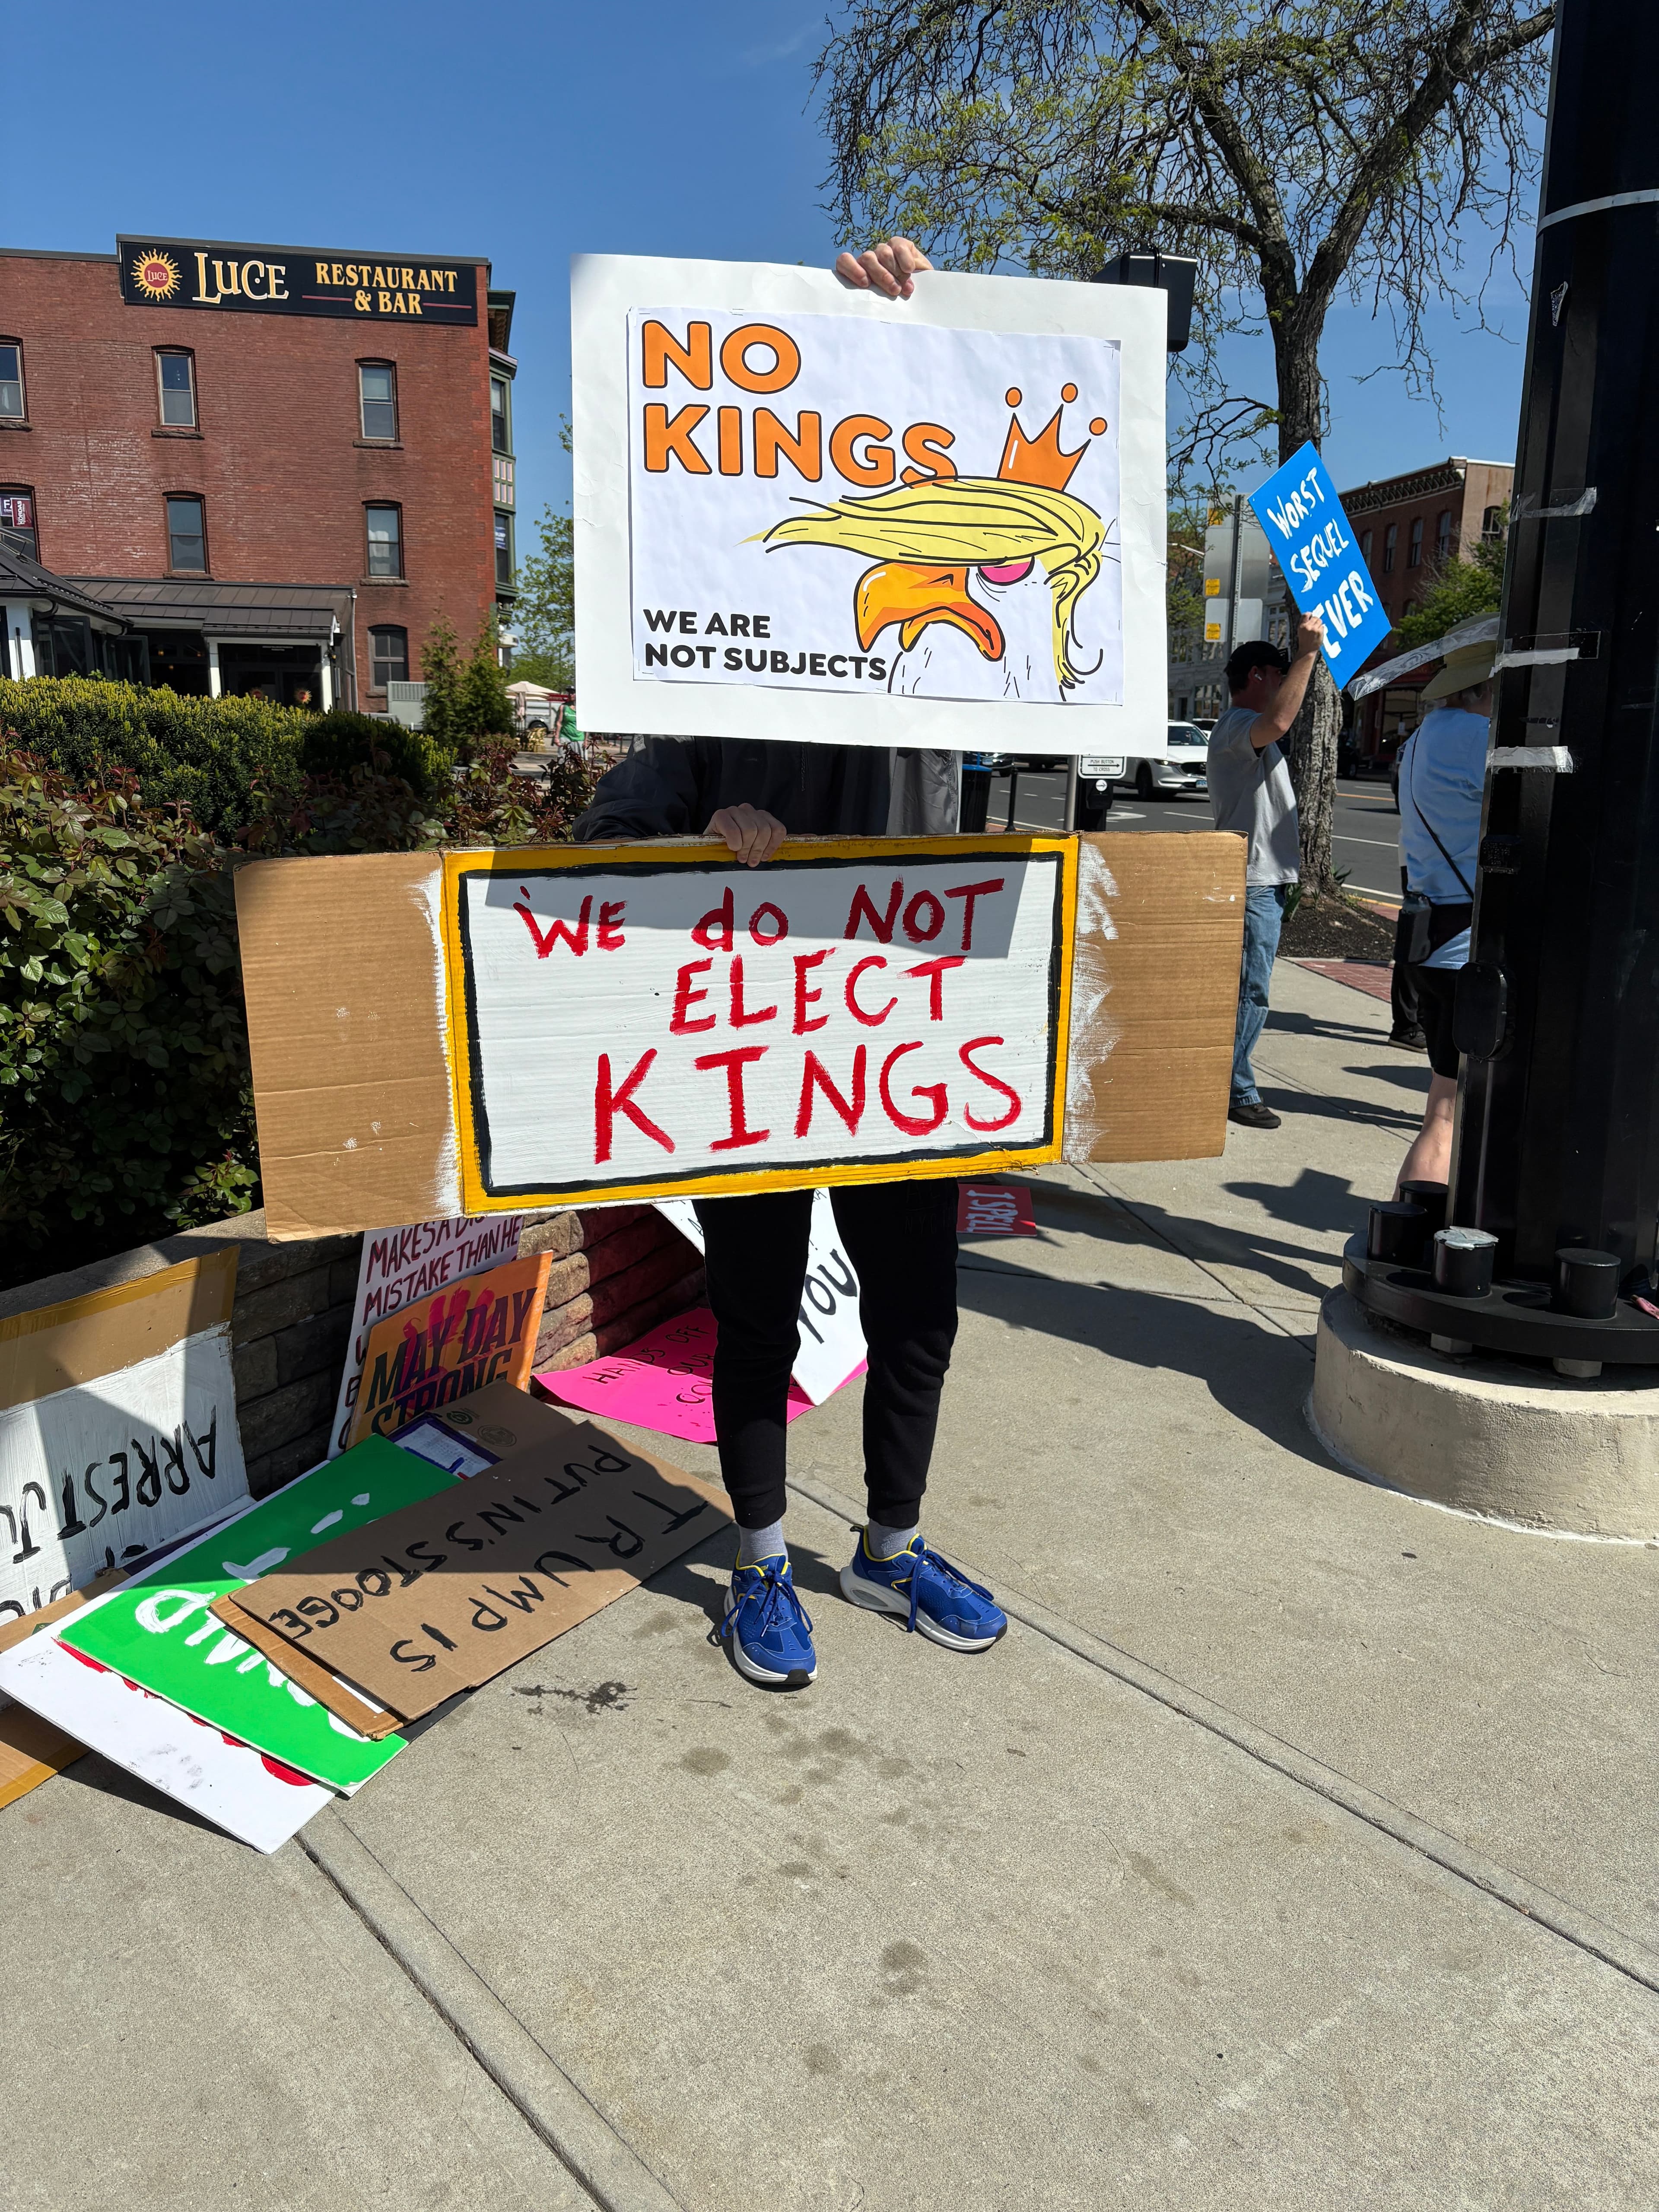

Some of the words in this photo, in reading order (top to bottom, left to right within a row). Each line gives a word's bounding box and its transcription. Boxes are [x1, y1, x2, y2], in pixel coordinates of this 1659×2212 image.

[192, 252, 289, 303] LUCE
[315, 262, 458, 292] RESTAURANT
[354, 290, 372, 312] &
[378, 291, 423, 315] BAR
[642, 320, 801, 394] NO
[643, 403, 957, 487] KINGS
[1267, 467, 1325, 540] WORST
[1290, 518, 1349, 592] SEQUEL
[643, 609, 697, 635] WE
[705, 612, 770, 639] ARE
[1312, 570, 1374, 658] EVER
[645, 642, 716, 669] NOT
[724, 648, 887, 681] SUBJECTS
[513, 895, 628, 959] WE
[691, 887, 789, 952] do
[844, 878, 1005, 951] NOT
[670, 947, 967, 1036] ELECT
[594, 1036, 1021, 1165] KINGS
[363, 1250, 454, 1326] MISTAKE
[457, 1224, 500, 1272] THAN
[501, 1216, 522, 1252] HE
[366, 1221, 435, 1284] MAKES
[436, 1219, 450, 1246] A
[364, 1316, 455, 1414] MAY
[457, 1287, 537, 1364] DAY
[582, 1348, 666, 1384] HANDS
[665, 1325, 710, 1344] OFF
[667, 1353, 714, 1376] OUR
[372, 1348, 512, 1437] STRONG
[57, 1405, 217, 1541] ARREST
[269, 1540, 448, 1640] STOOGE
[471, 1491, 710, 1632] TRUMP
[390, 1623, 458, 1672] IS
